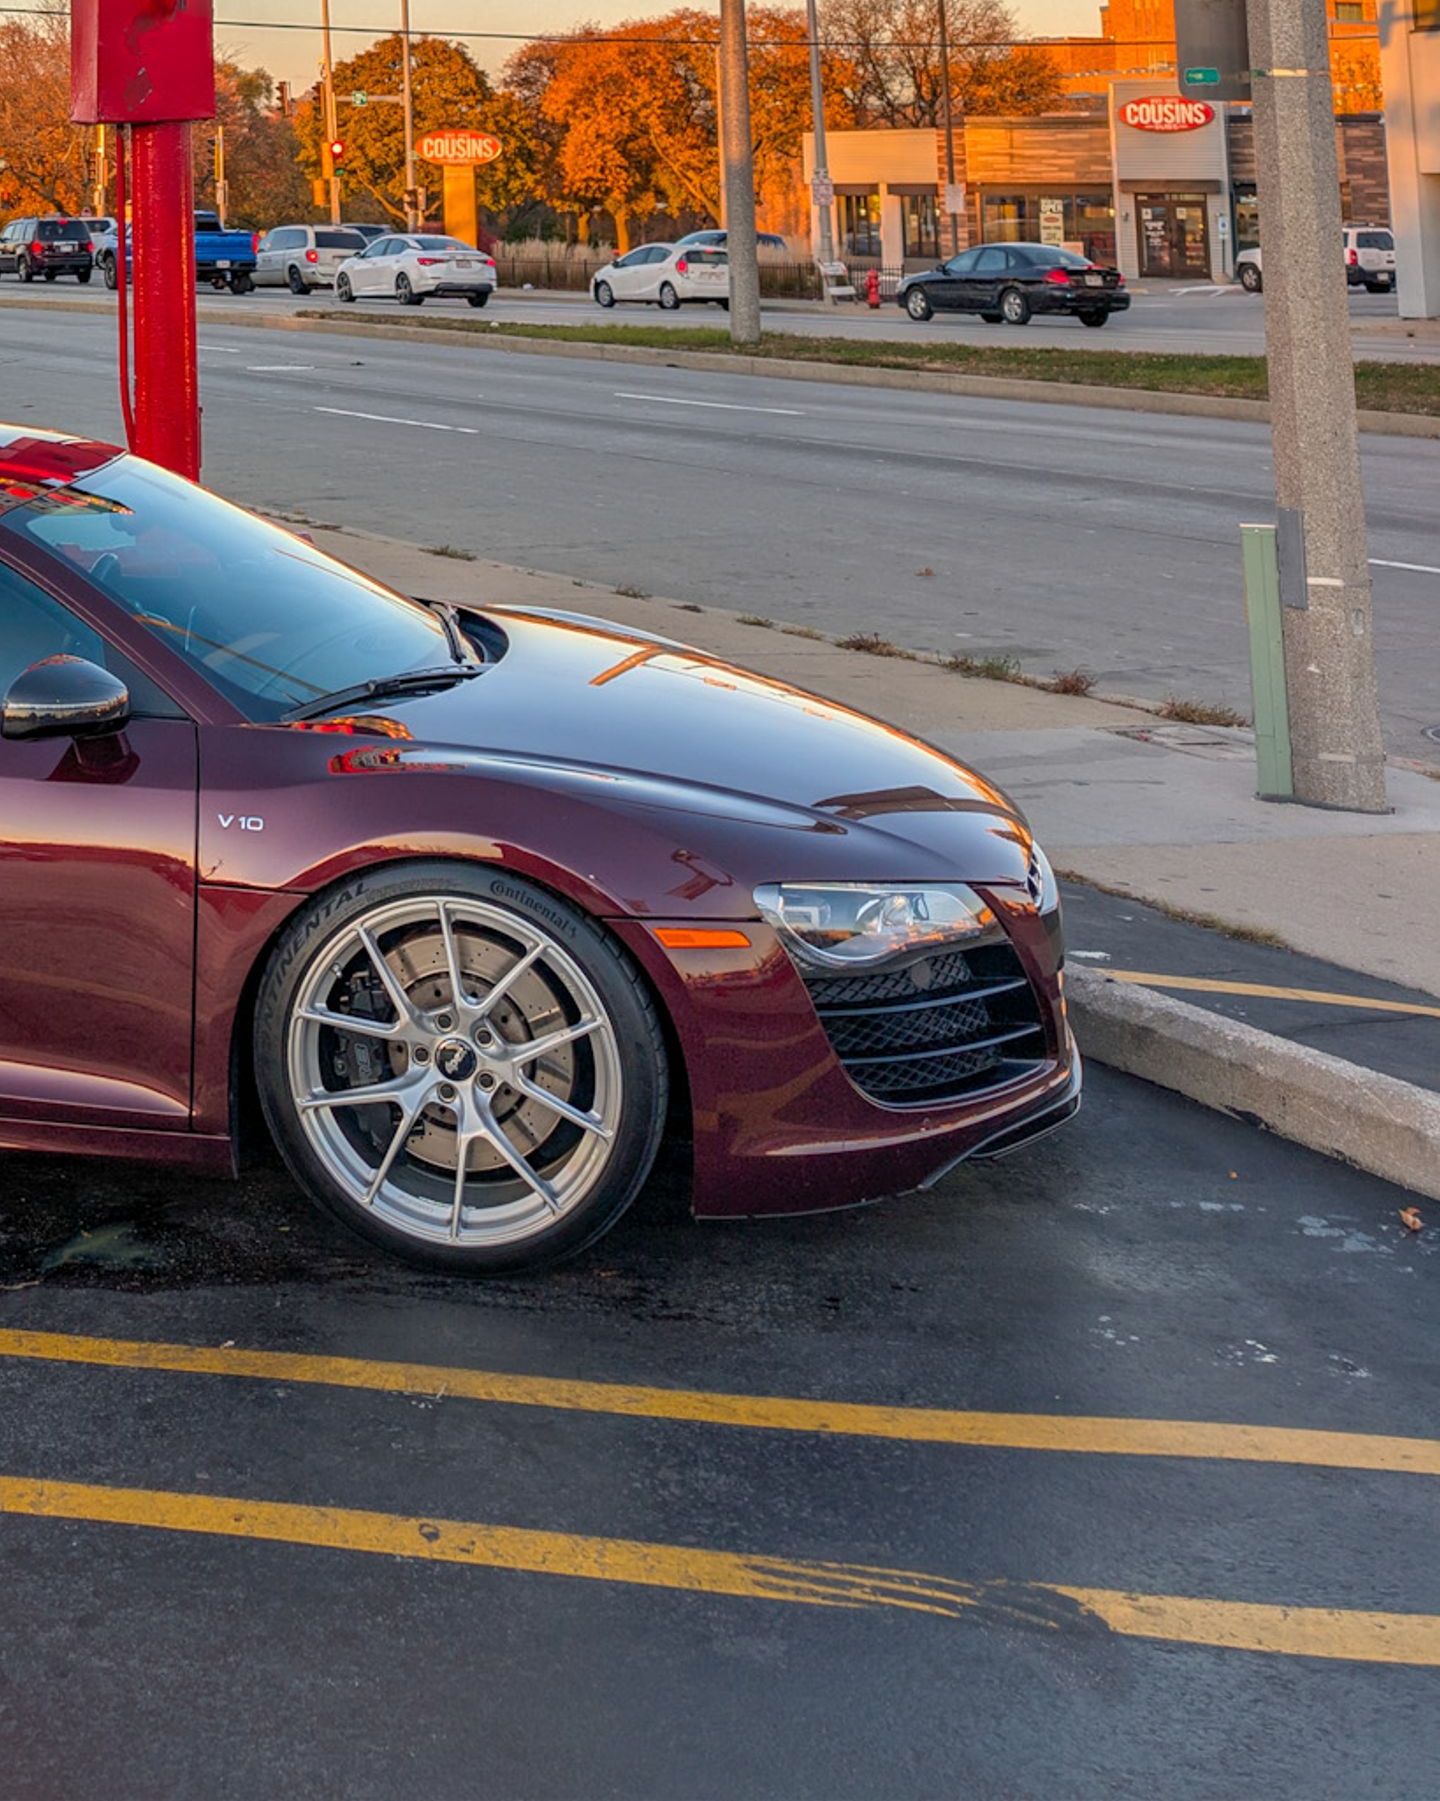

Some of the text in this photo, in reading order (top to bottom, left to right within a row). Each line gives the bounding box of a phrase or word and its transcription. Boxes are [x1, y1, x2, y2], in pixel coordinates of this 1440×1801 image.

[1125, 102, 1206, 125] COUSINS
[423, 137, 494, 159] COUSINS
[217, 813, 265, 832] V10
[489, 879, 572, 932] Continental
